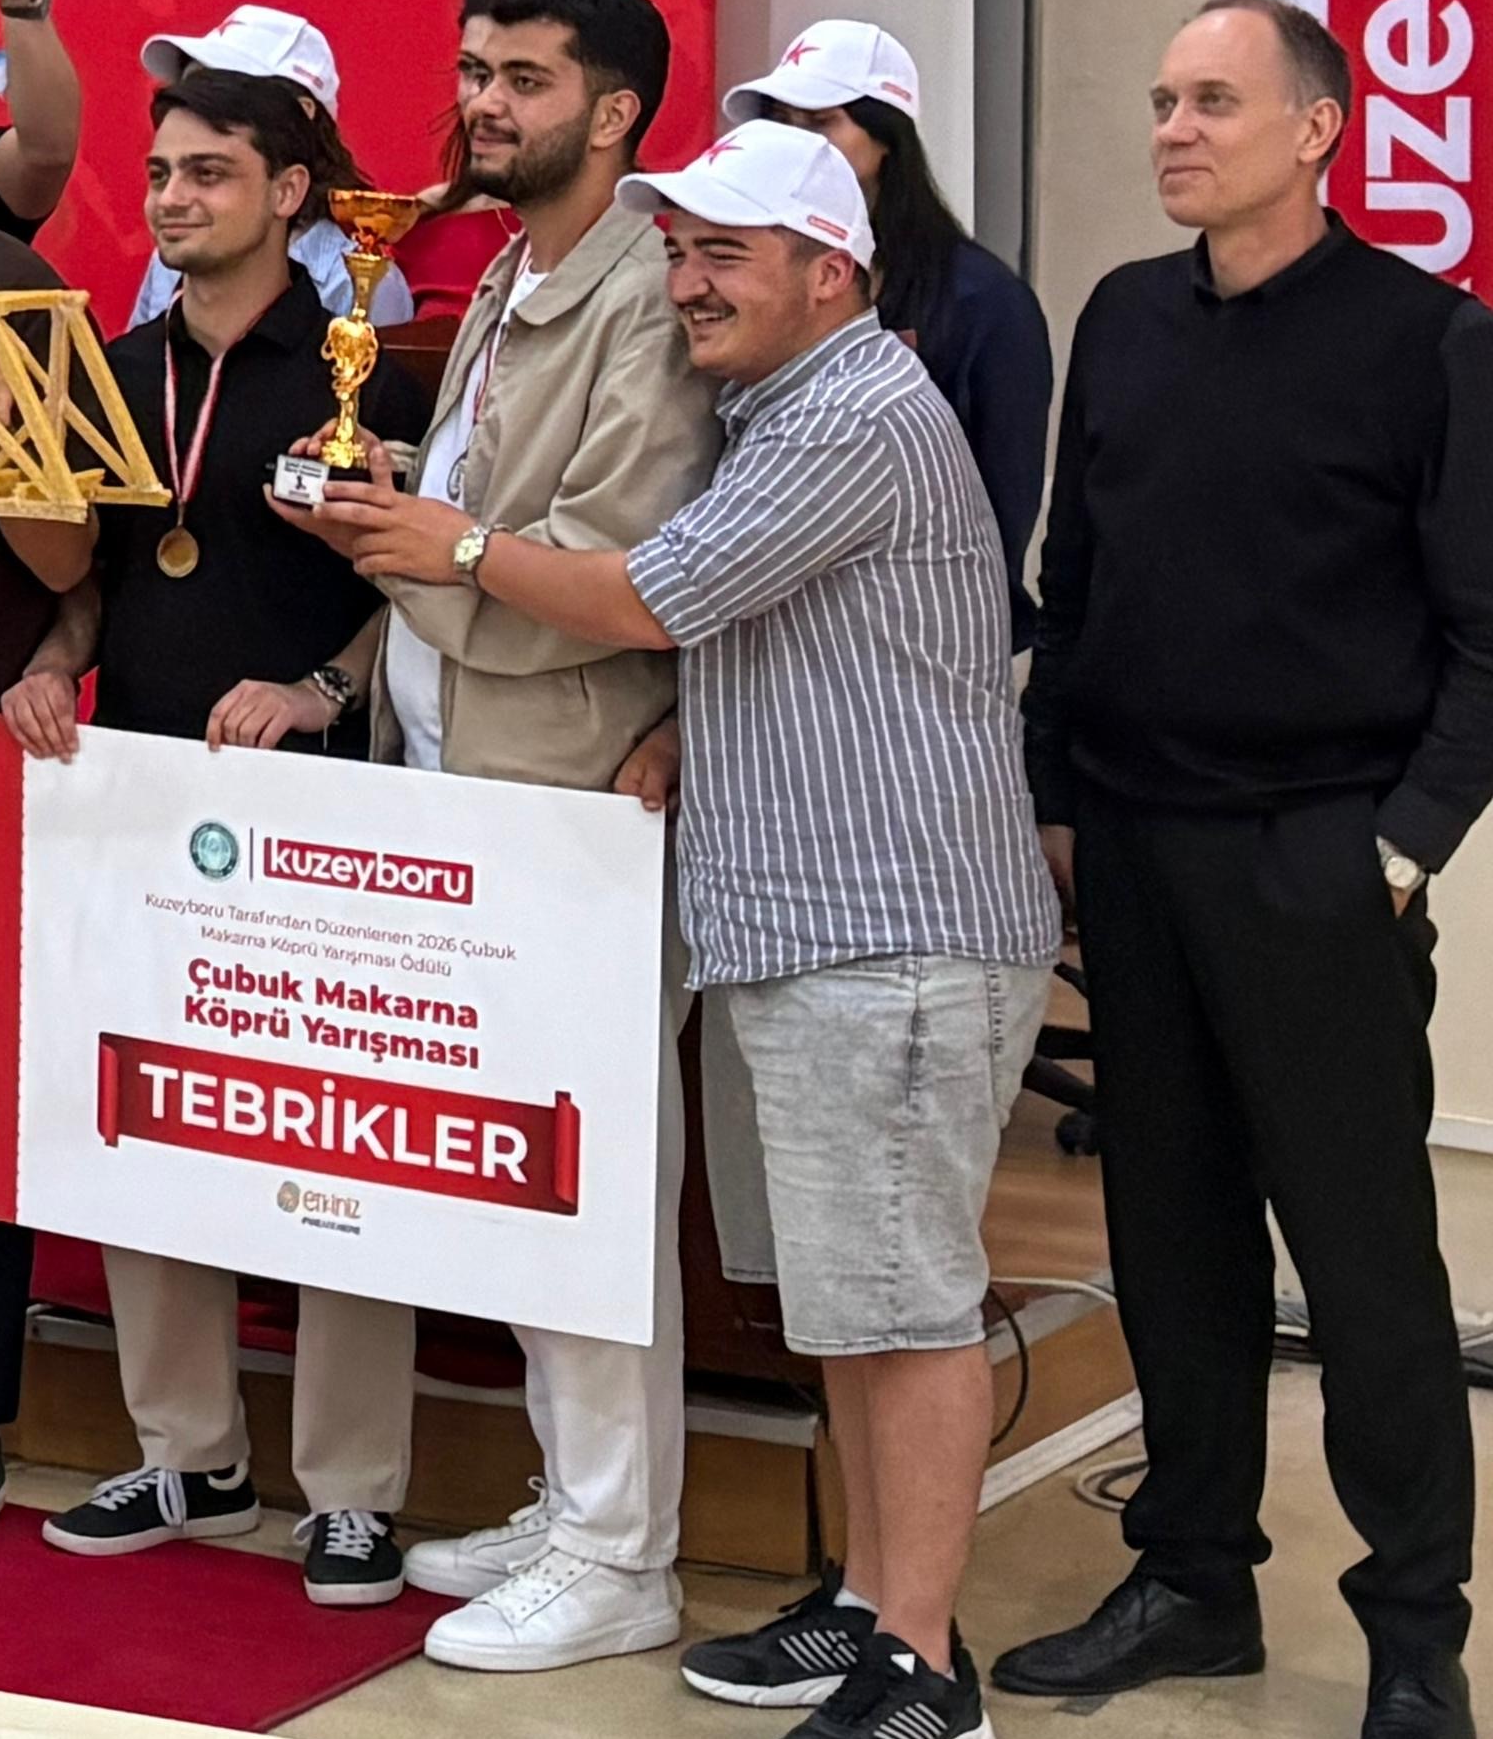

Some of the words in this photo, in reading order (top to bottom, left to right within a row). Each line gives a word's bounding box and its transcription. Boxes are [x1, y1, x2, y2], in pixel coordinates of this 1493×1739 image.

[270, 837, 466, 898] kuzeyboru
[144, 893, 224, 918] Kuzeyboru
[227, 904, 311, 931] Tarafından
[315, 918, 412, 946] Düzenlenen
[416, 933, 457, 953] 2026
[460, 939, 517, 961] Çubuk
[200, 925, 266, 949] Makarna
[270, 935, 318, 959] Köprü
[322, 942, 396, 968] Yarışması
[400, 952, 452, 977] Ödülü
[187, 957, 304, 1003] Çubuk
[314, 977, 479, 1029] Makarna
[184, 995, 290, 1039] Köprü
[301, 1013, 480, 1069] Yarışması
[138, 1062, 528, 1183] TEBRİKLER
